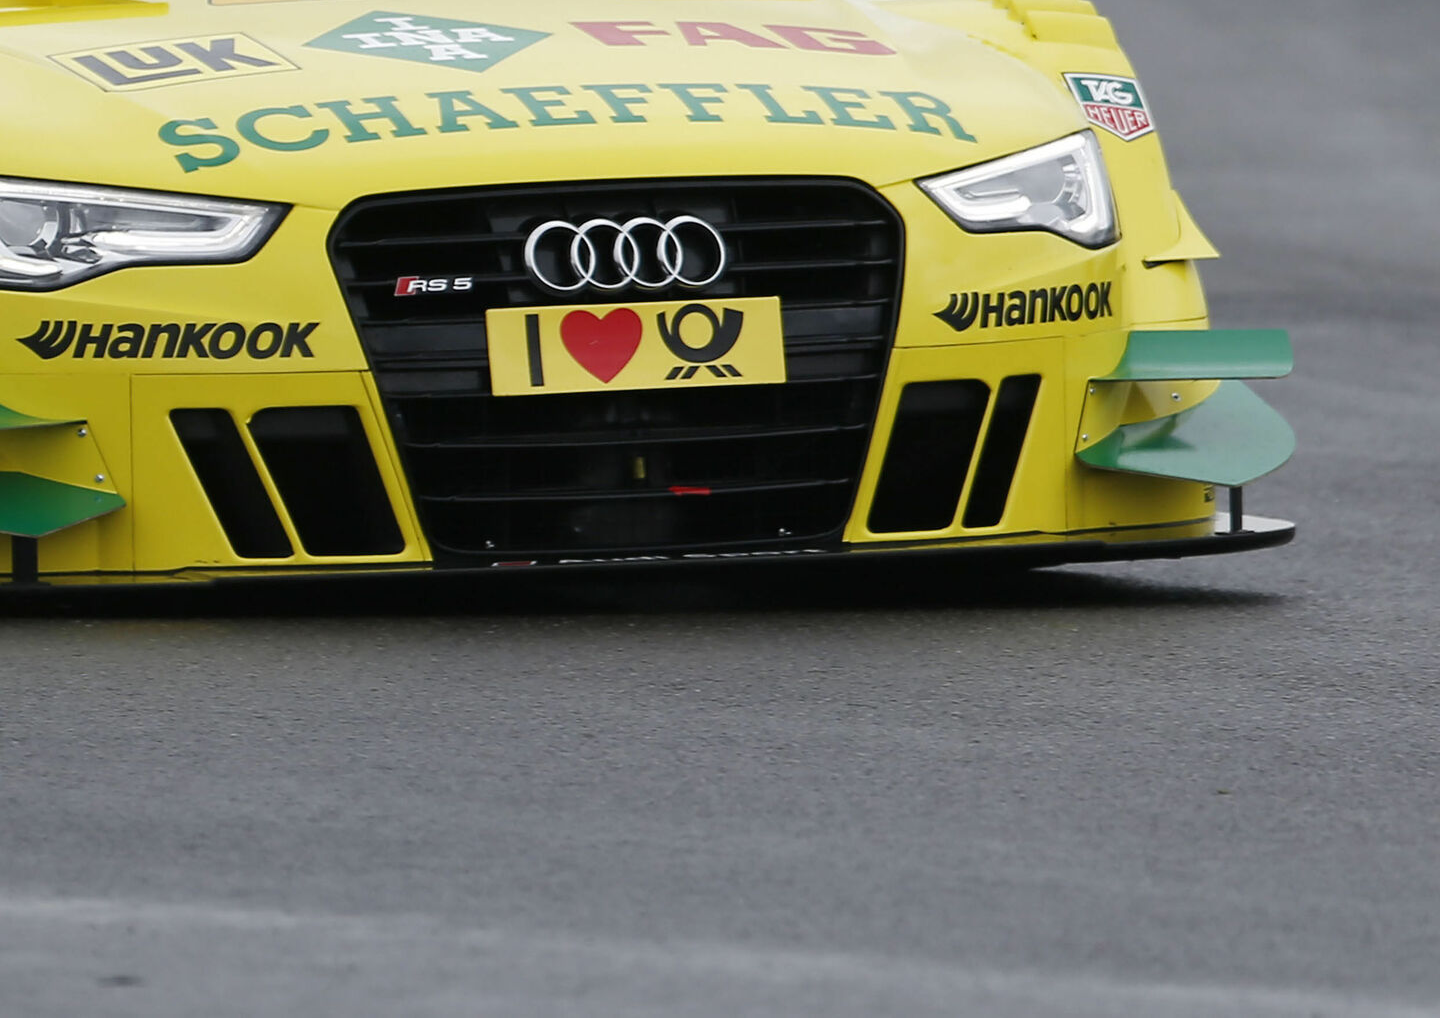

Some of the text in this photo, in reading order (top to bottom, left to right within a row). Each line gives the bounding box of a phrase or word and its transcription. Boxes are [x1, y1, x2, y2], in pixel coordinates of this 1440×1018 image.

[569, 21, 898, 56] FAG
[1080, 80, 1133, 104] TAG
[158, 82, 979, 174] SCHAEFFLER
[1087, 105, 1148, 136] HEUER
[407, 277, 472, 292] RS 5
[526, 313, 544, 387] I
